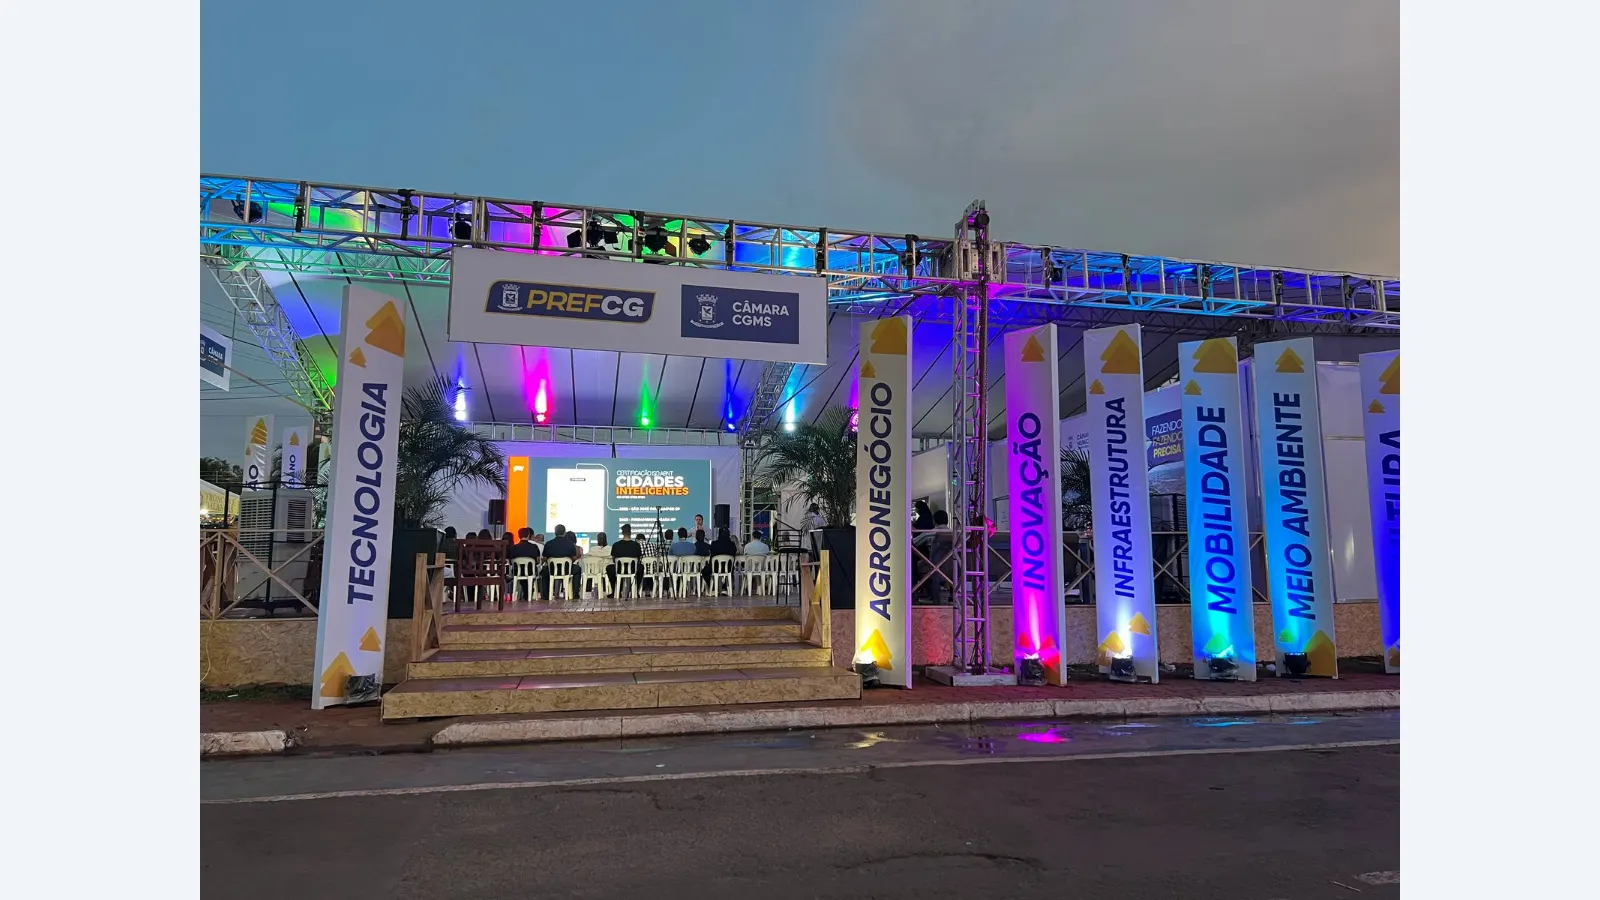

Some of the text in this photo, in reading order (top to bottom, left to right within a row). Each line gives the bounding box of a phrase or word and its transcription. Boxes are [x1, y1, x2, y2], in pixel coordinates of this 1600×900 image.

[526, 289, 645, 317] PREFCG
[732, 300, 789, 316] CÂMARA
[732, 314, 772, 327] CGMS
[1152, 418, 1182, 436] FAZENDO
[1153, 444, 1181, 458] PRECISA
[347, 382, 388, 604] TECNOLOGIA
[615, 475, 684, 488] CIDADES
[615, 486, 689, 496] INTELIGENTES
[863, 382, 892, 621] AGRONEGÓCIO
[1013, 412, 1049, 591] INOVAÇÃO
[1104, 396, 1135, 598] INFRAESTRUTURA
[1196, 405, 1237, 615] MOBILIDADE
[1273, 392, 1316, 620] MEIO AMBIENTE
